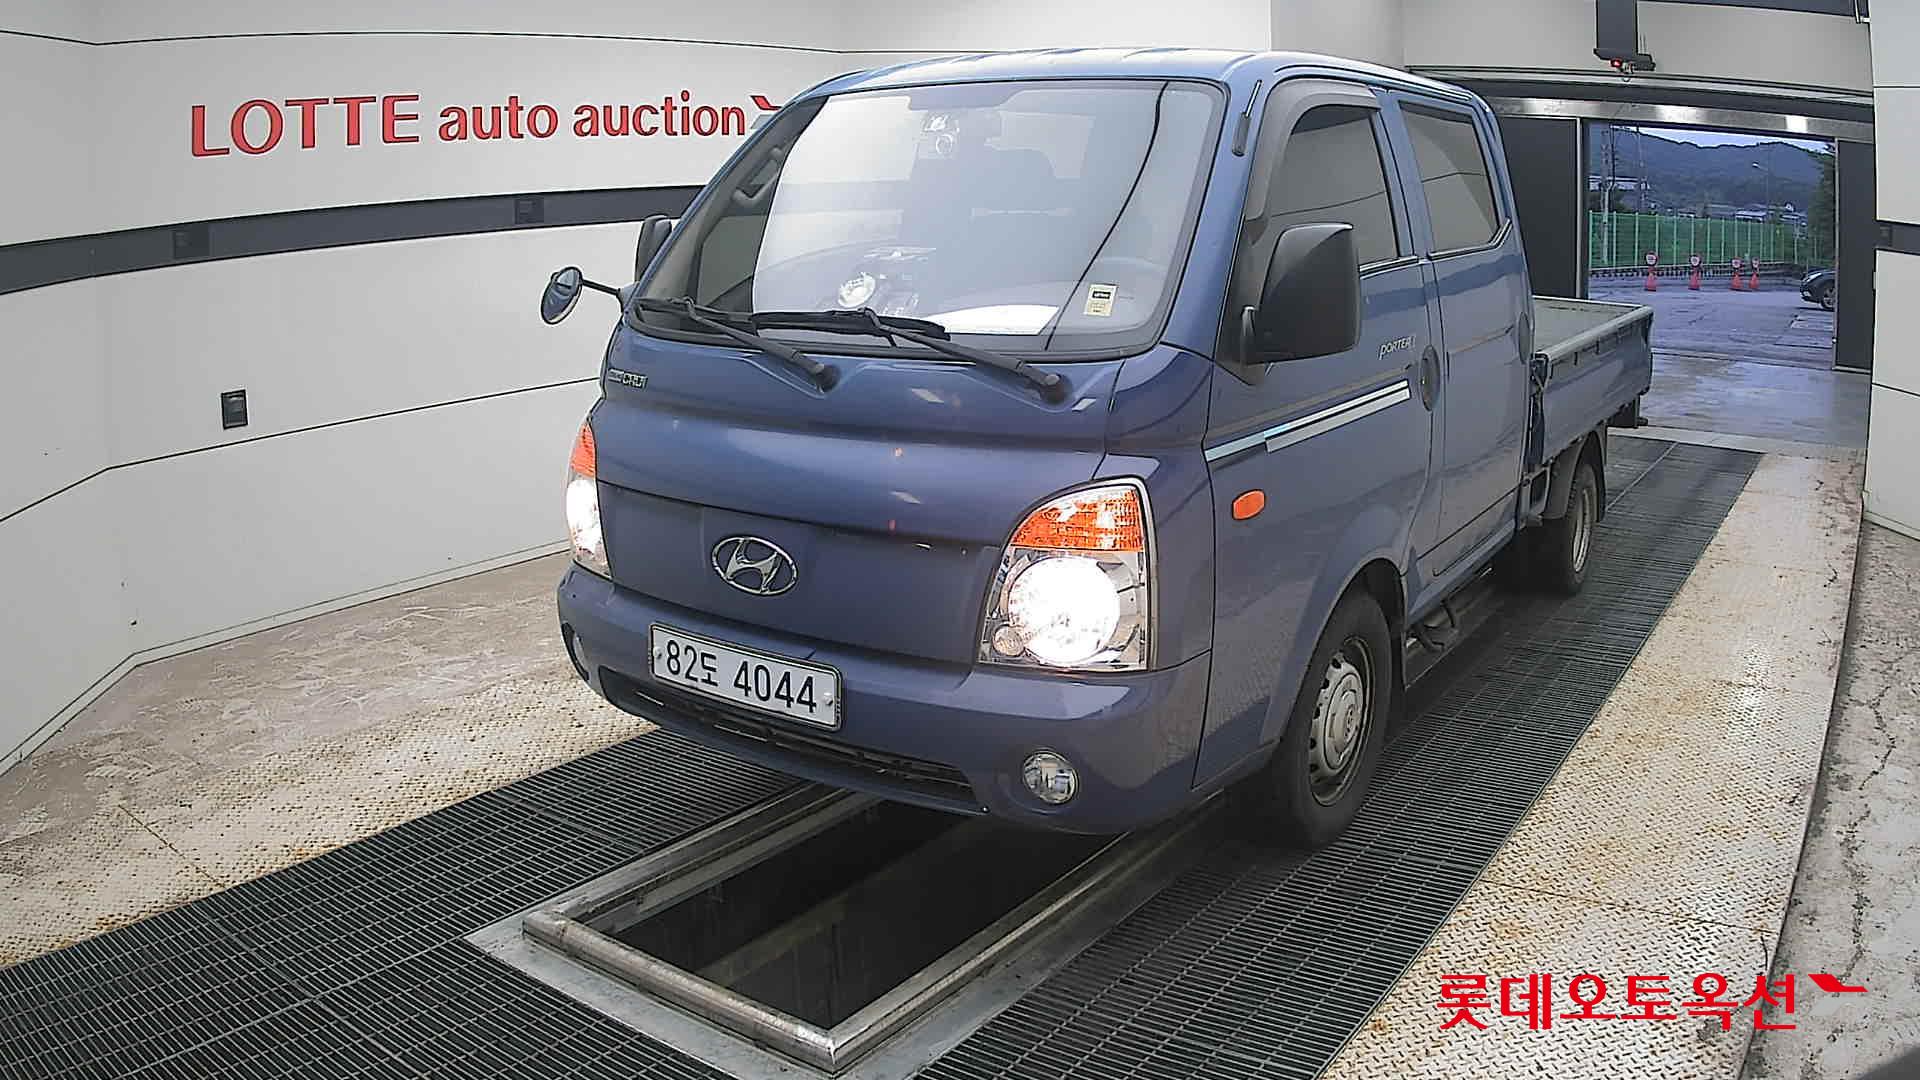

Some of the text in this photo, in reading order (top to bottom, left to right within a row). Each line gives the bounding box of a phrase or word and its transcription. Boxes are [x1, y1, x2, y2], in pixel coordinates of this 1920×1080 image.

[190, 91, 746, 158] LOTTE auto auction
[666, 639, 817, 713] 82도 4044
